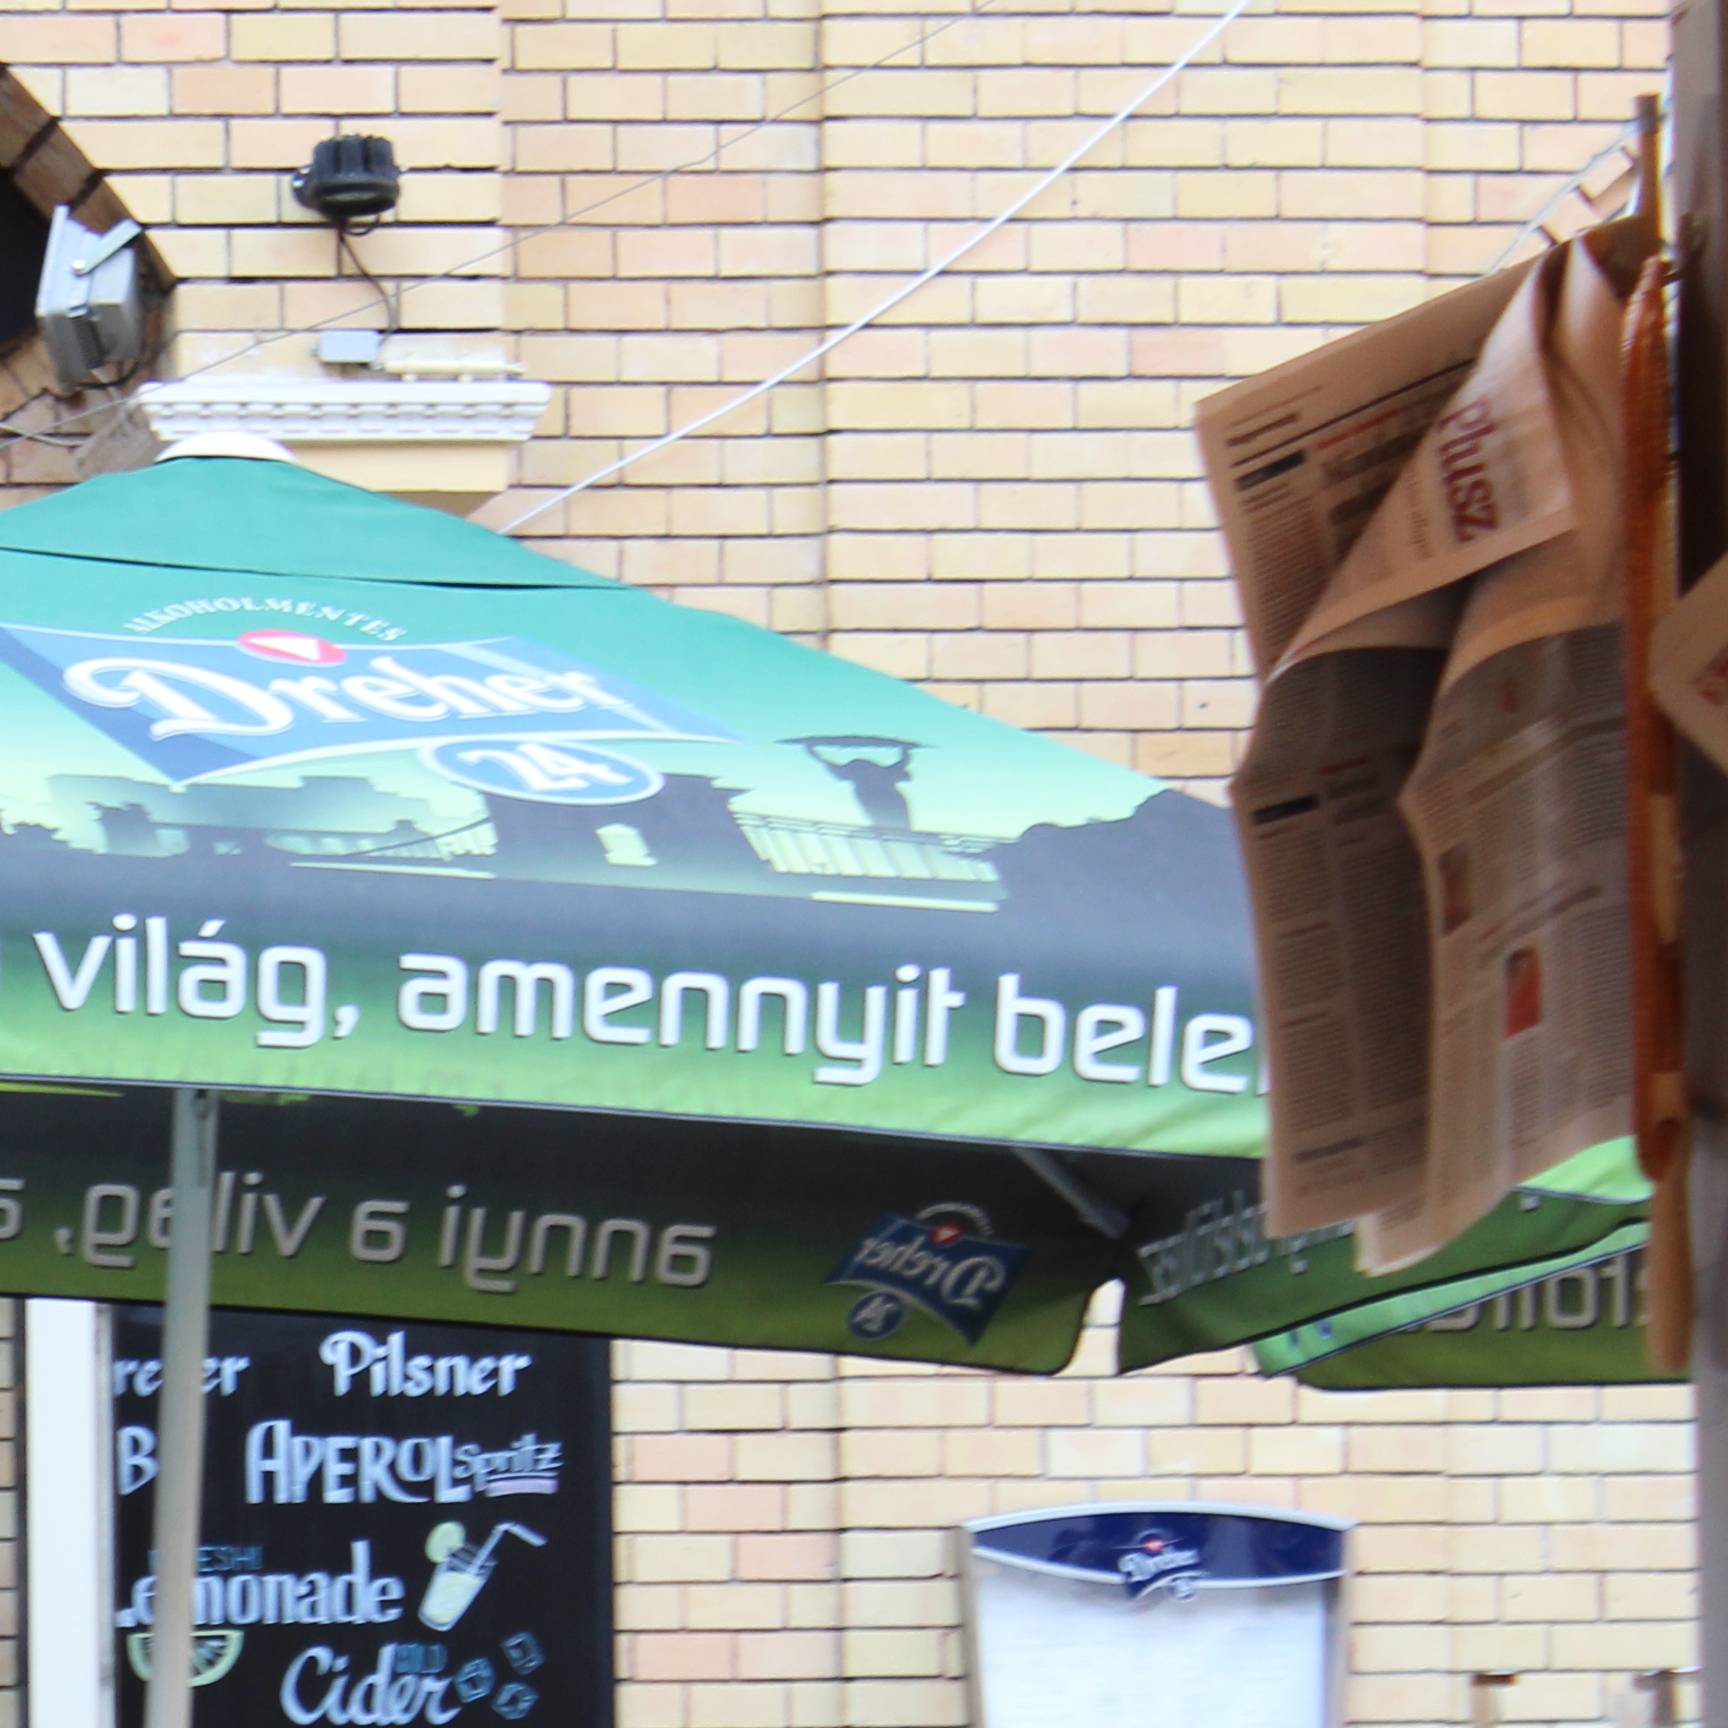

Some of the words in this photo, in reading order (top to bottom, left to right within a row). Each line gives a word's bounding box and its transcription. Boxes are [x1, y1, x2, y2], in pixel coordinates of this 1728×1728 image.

[1436, 395, 1500, 545] Plusz
[123, 597, 408, 642] ALKOHOLMENTES
[63, 655, 637, 742] Dreher
[456, 742, 634, 792] 24
[32, 912, 361, 1048] világ,
[397, 952, 966, 1087] amennyit
[318, 1329, 534, 1398] Pilsner
[245, 1417, 474, 1505] APEROL
[453, 1432, 566, 1494] Spritz
[279, 1642, 463, 1726] Cider
